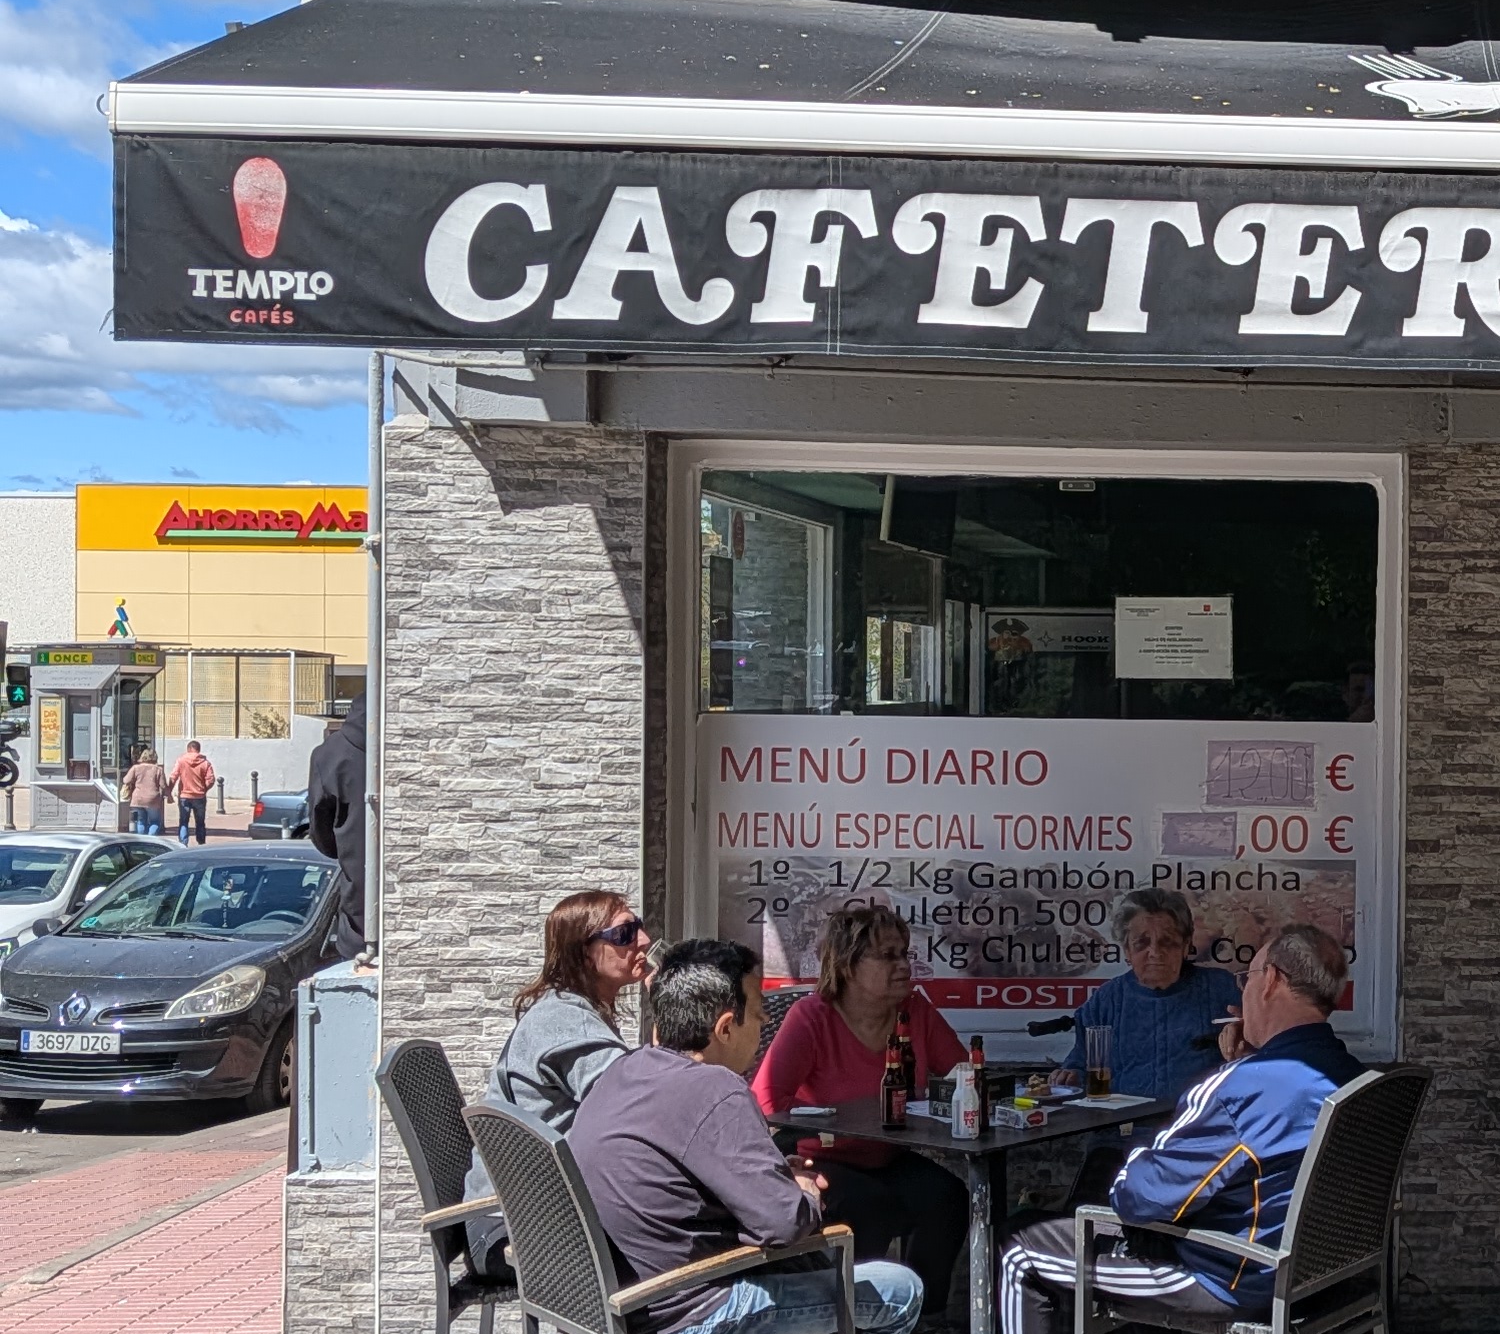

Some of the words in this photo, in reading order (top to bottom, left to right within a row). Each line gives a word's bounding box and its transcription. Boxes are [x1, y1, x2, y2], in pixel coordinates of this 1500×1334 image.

[188, 268, 333, 300] TEMPLO
[230, 304, 294, 324] CAFÉS
[1061, 635, 1110, 643] HOOK
[53, 654, 88, 663] ONCE
[137, 654, 155, 663] ONCE
[719, 737, 867, 784] MENÚ
[886, 748, 1049, 786] DIARIO
[1325, 754, 1355, 792] €
[717, 802, 822, 849] MENÚ
[835, 811, 984, 850] ESPECIAL
[993, 814, 1133, 852] TORMES
[1324, 816, 1354, 853] €
[748, 859, 791, 887] 1º
[828, 857, 893, 893] 1/2
[909, 861, 954, 894] Kg
[967, 860, 1135, 890] Gambón
[1152, 862, 1301, 892] Plancha
[747, 897, 791, 925] 2º
[1035, 899, 1106, 927] 500
[927, 936, 969, 970] Kg
[982, 935, 1125, 964] Chuleta
[976, 985, 1097, 1006] POST
[36, 1034, 75, 1051] 3697
[81, 1035, 111, 1052] DZG
